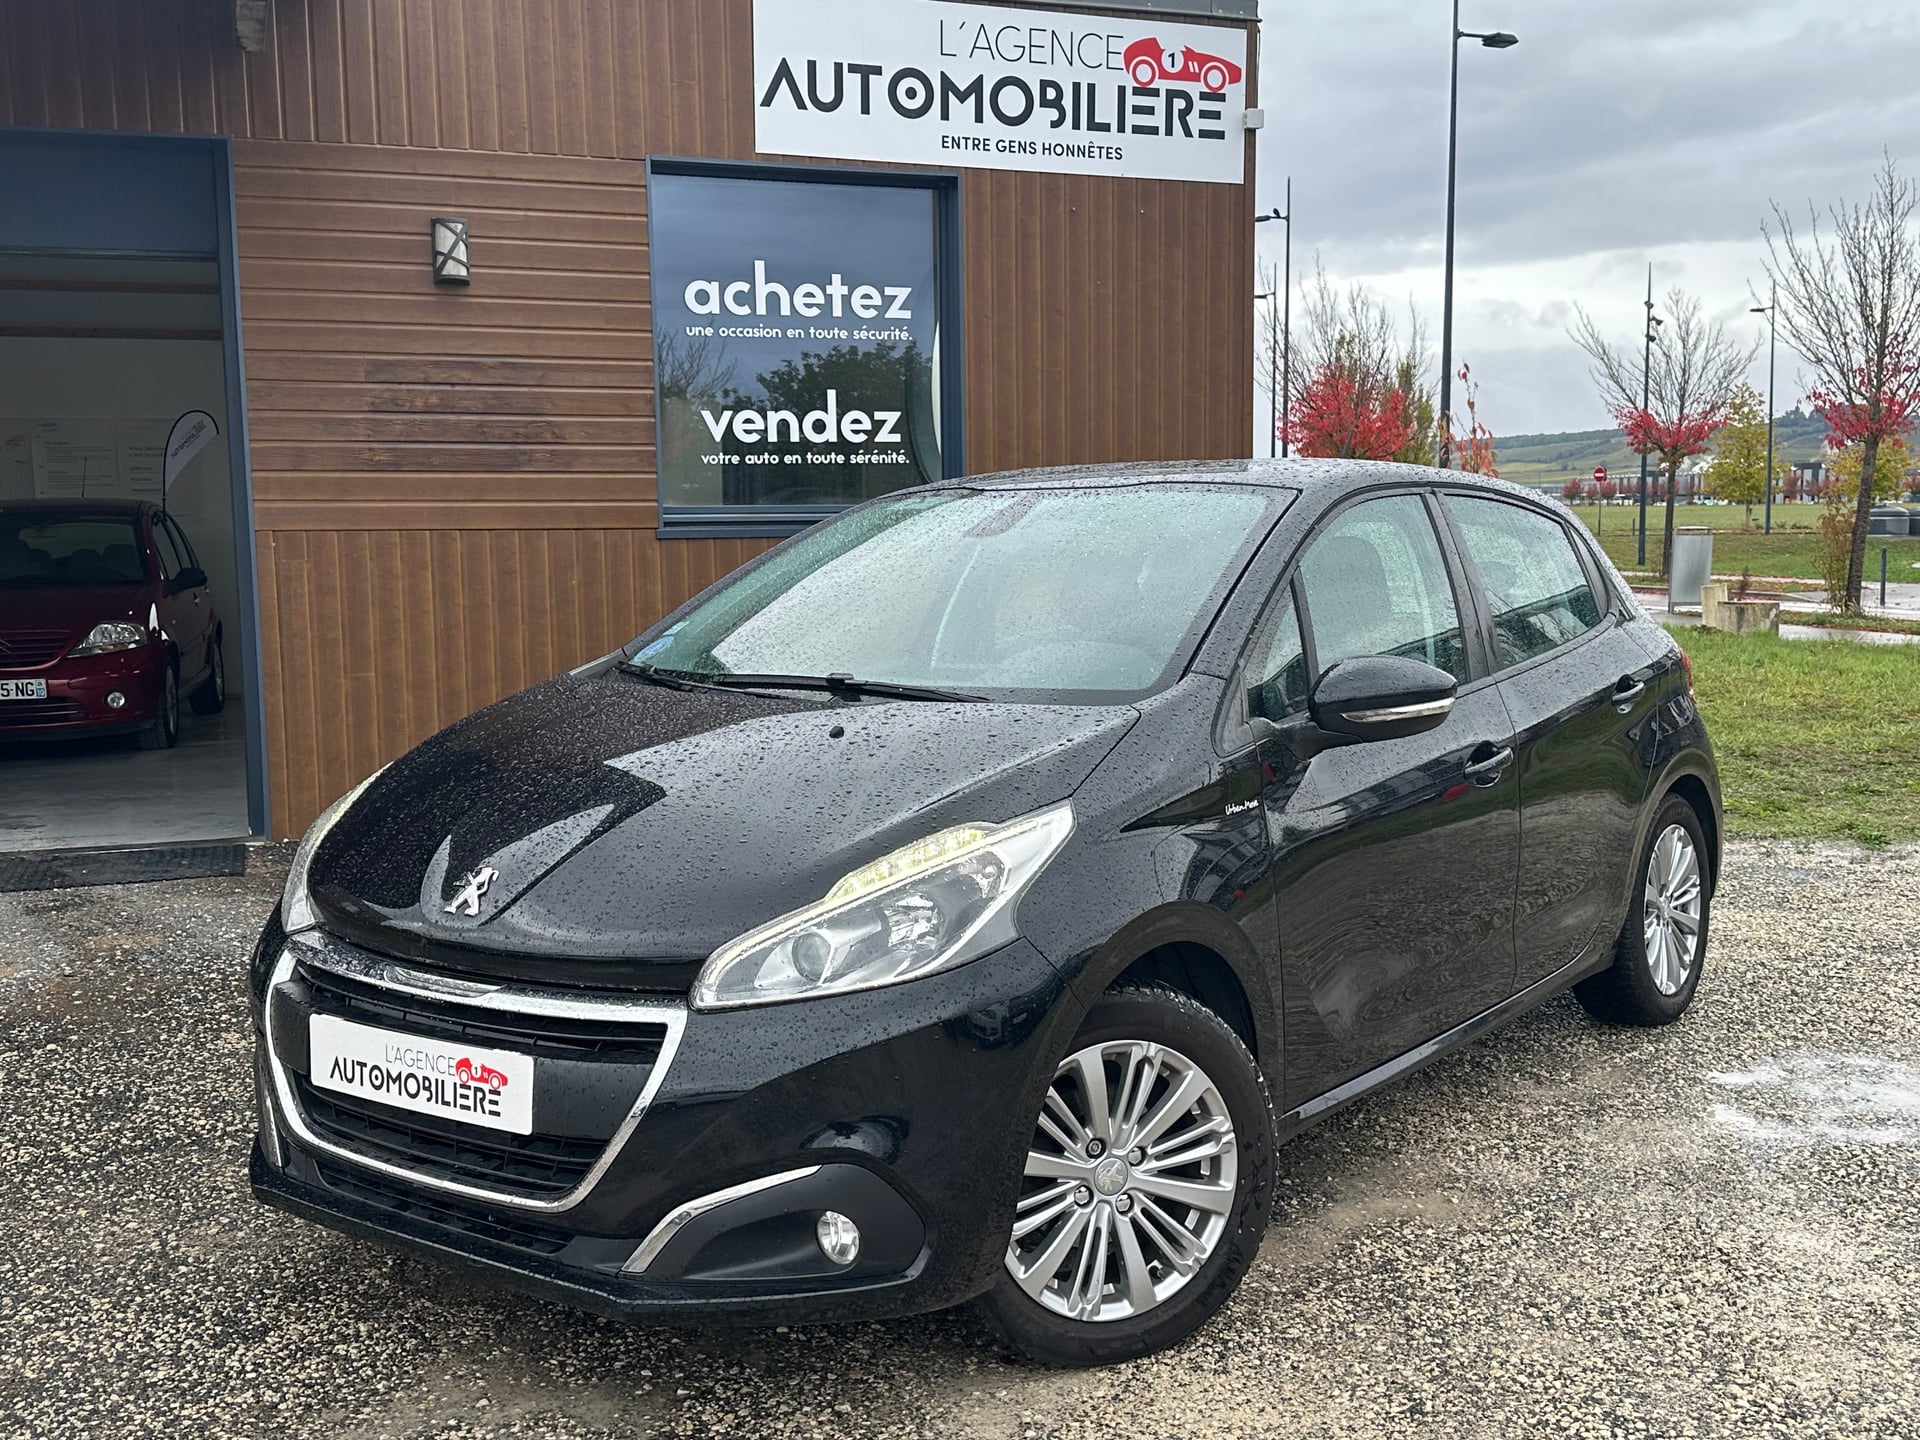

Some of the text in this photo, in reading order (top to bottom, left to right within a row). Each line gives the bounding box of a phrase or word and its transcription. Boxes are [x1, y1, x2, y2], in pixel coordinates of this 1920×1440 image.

[940, 19, 1124, 70] L'AGENCE
[1167, 52, 1176, 68] 1
[941, 135, 1123, 160] ENTRE GENS HONNÊTES
[684, 260, 912, 319] achetez
[686, 323, 913, 341] une occasion en toute sécurité.
[700, 389, 901, 443] vendez
[701, 450, 910, 464] votre auto en toute sérénité.
[386, 1043, 456, 1076] L'AGENCE
